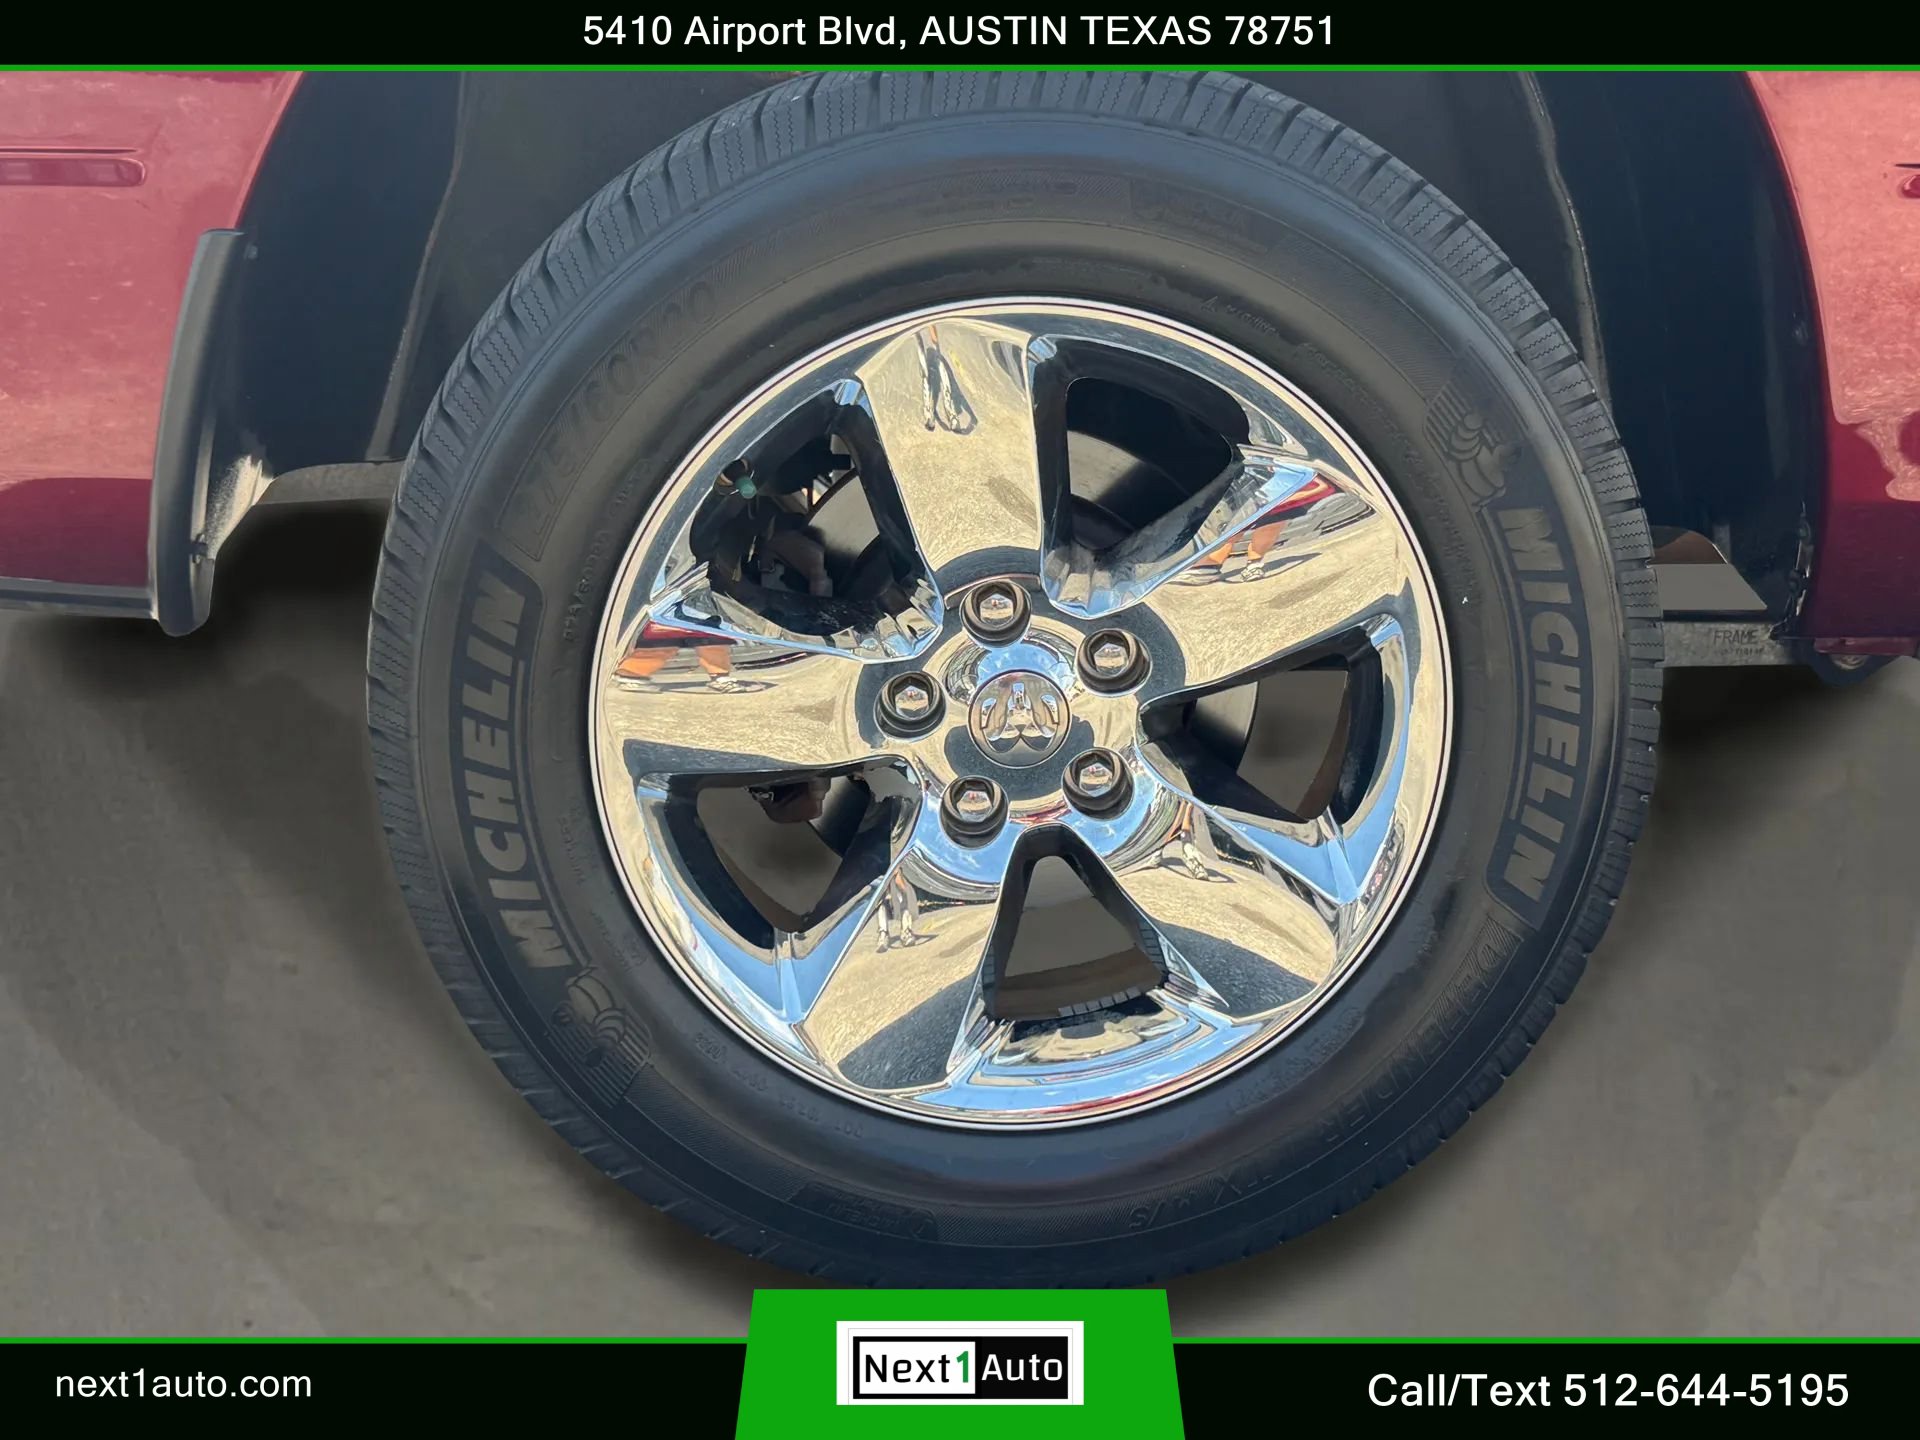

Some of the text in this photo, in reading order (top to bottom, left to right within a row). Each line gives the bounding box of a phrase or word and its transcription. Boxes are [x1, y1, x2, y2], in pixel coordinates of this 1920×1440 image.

[463, 570, 576, 969] MICHELIN
[1498, 506, 1581, 902] MICHELIN
[1712, 629, 1760, 646] FRAME
